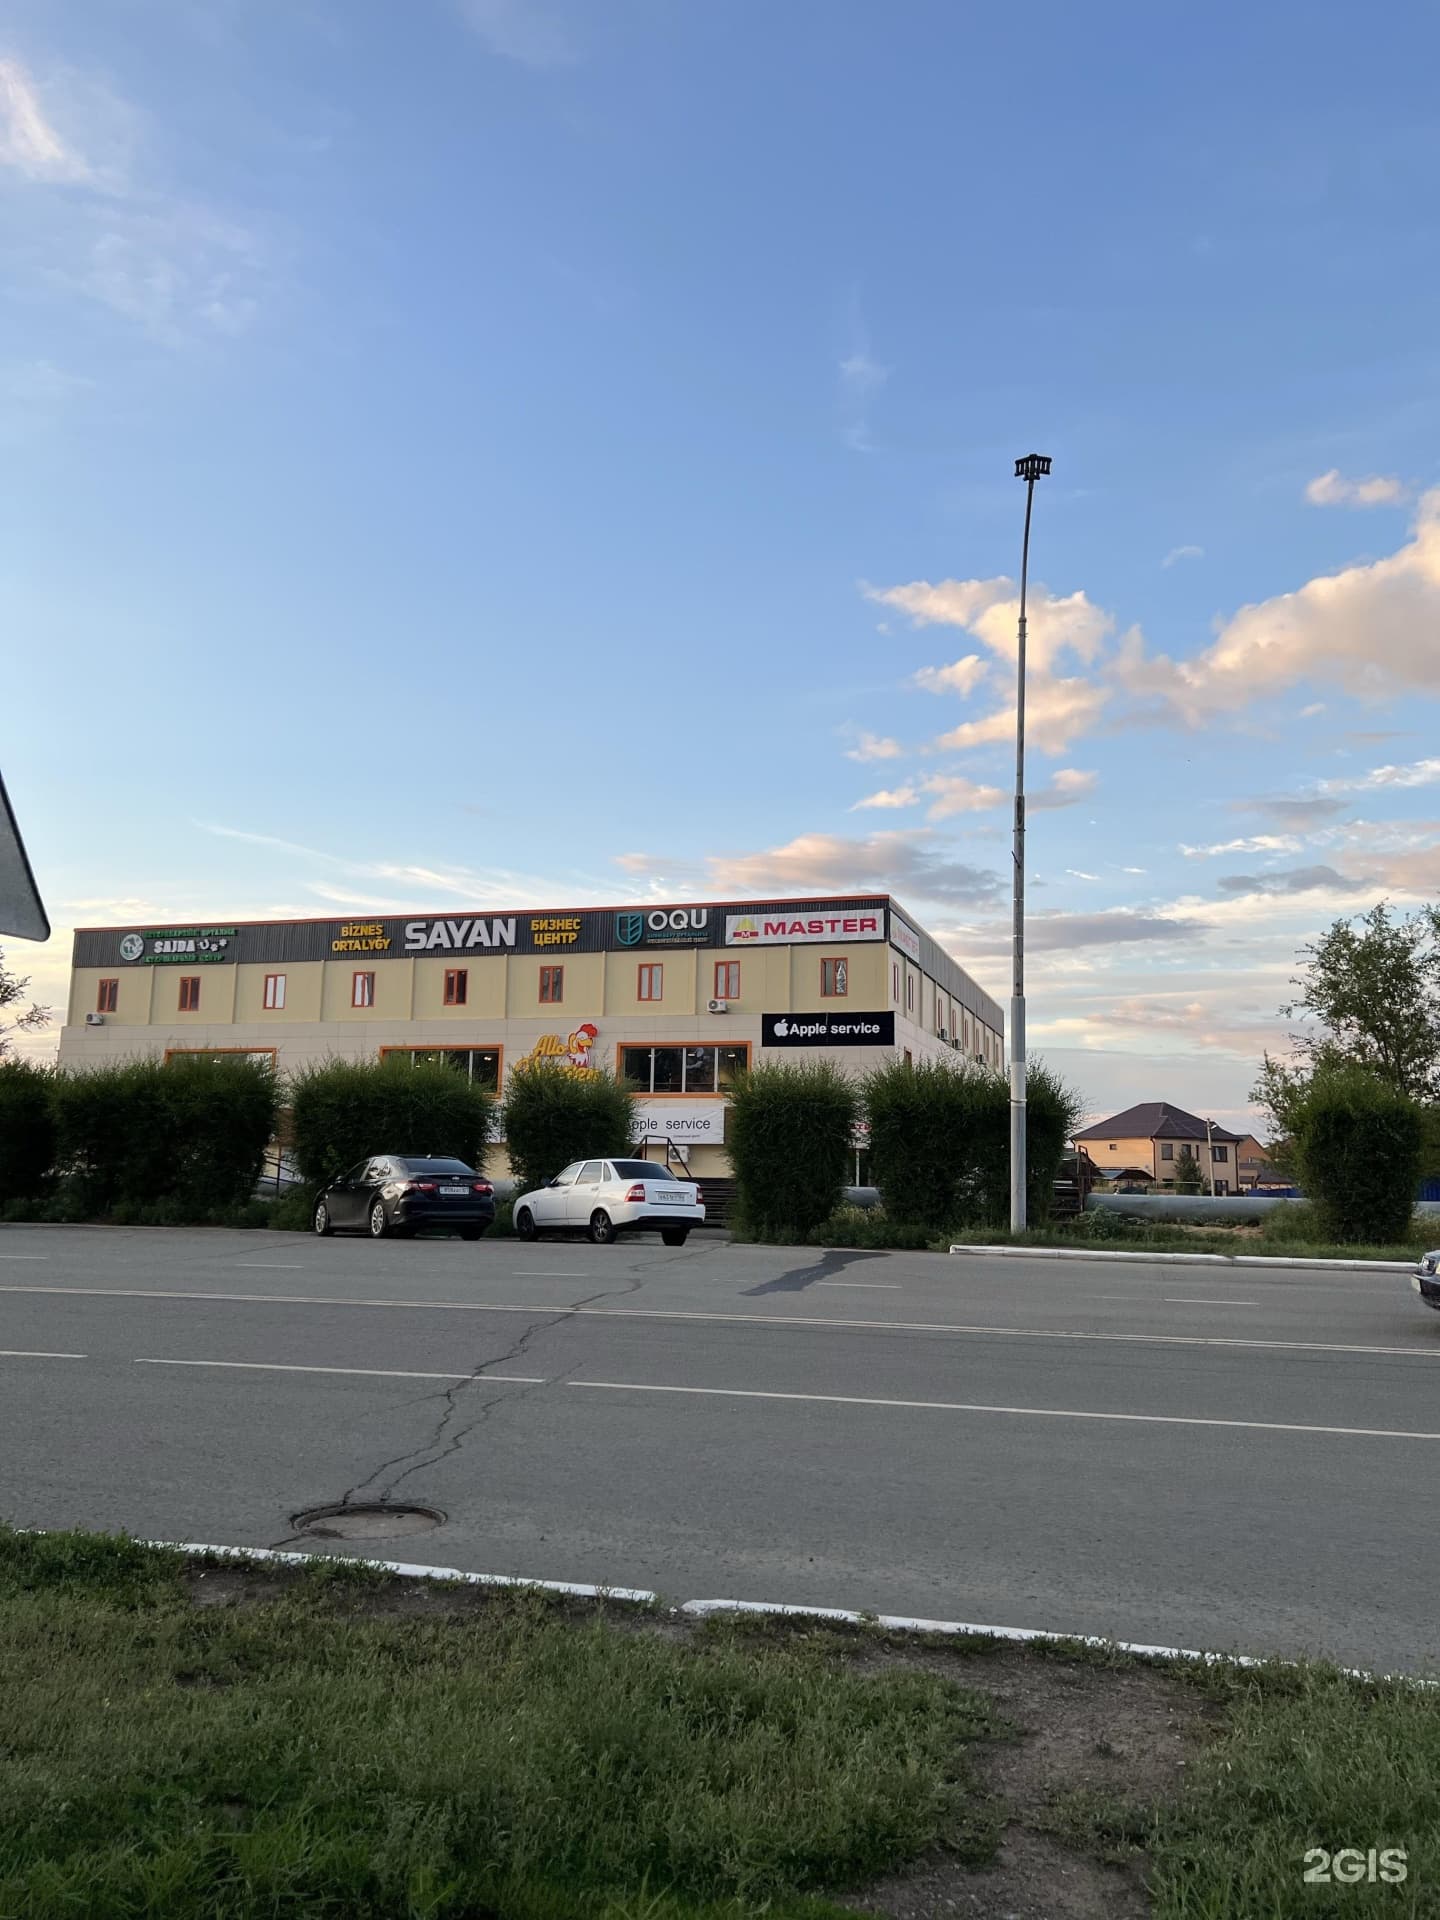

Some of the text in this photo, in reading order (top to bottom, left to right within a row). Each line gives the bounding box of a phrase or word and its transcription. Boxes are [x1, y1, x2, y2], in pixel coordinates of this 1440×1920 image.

[530, 918, 581, 931] БИЗНЕС
[647, 908, 708, 931] OQU
[764, 917, 877, 936] MASTER
[404, 918, 517, 950] SAYAN
[533, 932, 578, 947] ЦЕНТР
[153, 939, 196, 954] SAJDA
[789, 1022, 881, 1037] Apple service
[533, 1034, 568, 1057] Allo
[631, 1117, 711, 1132] pple service
